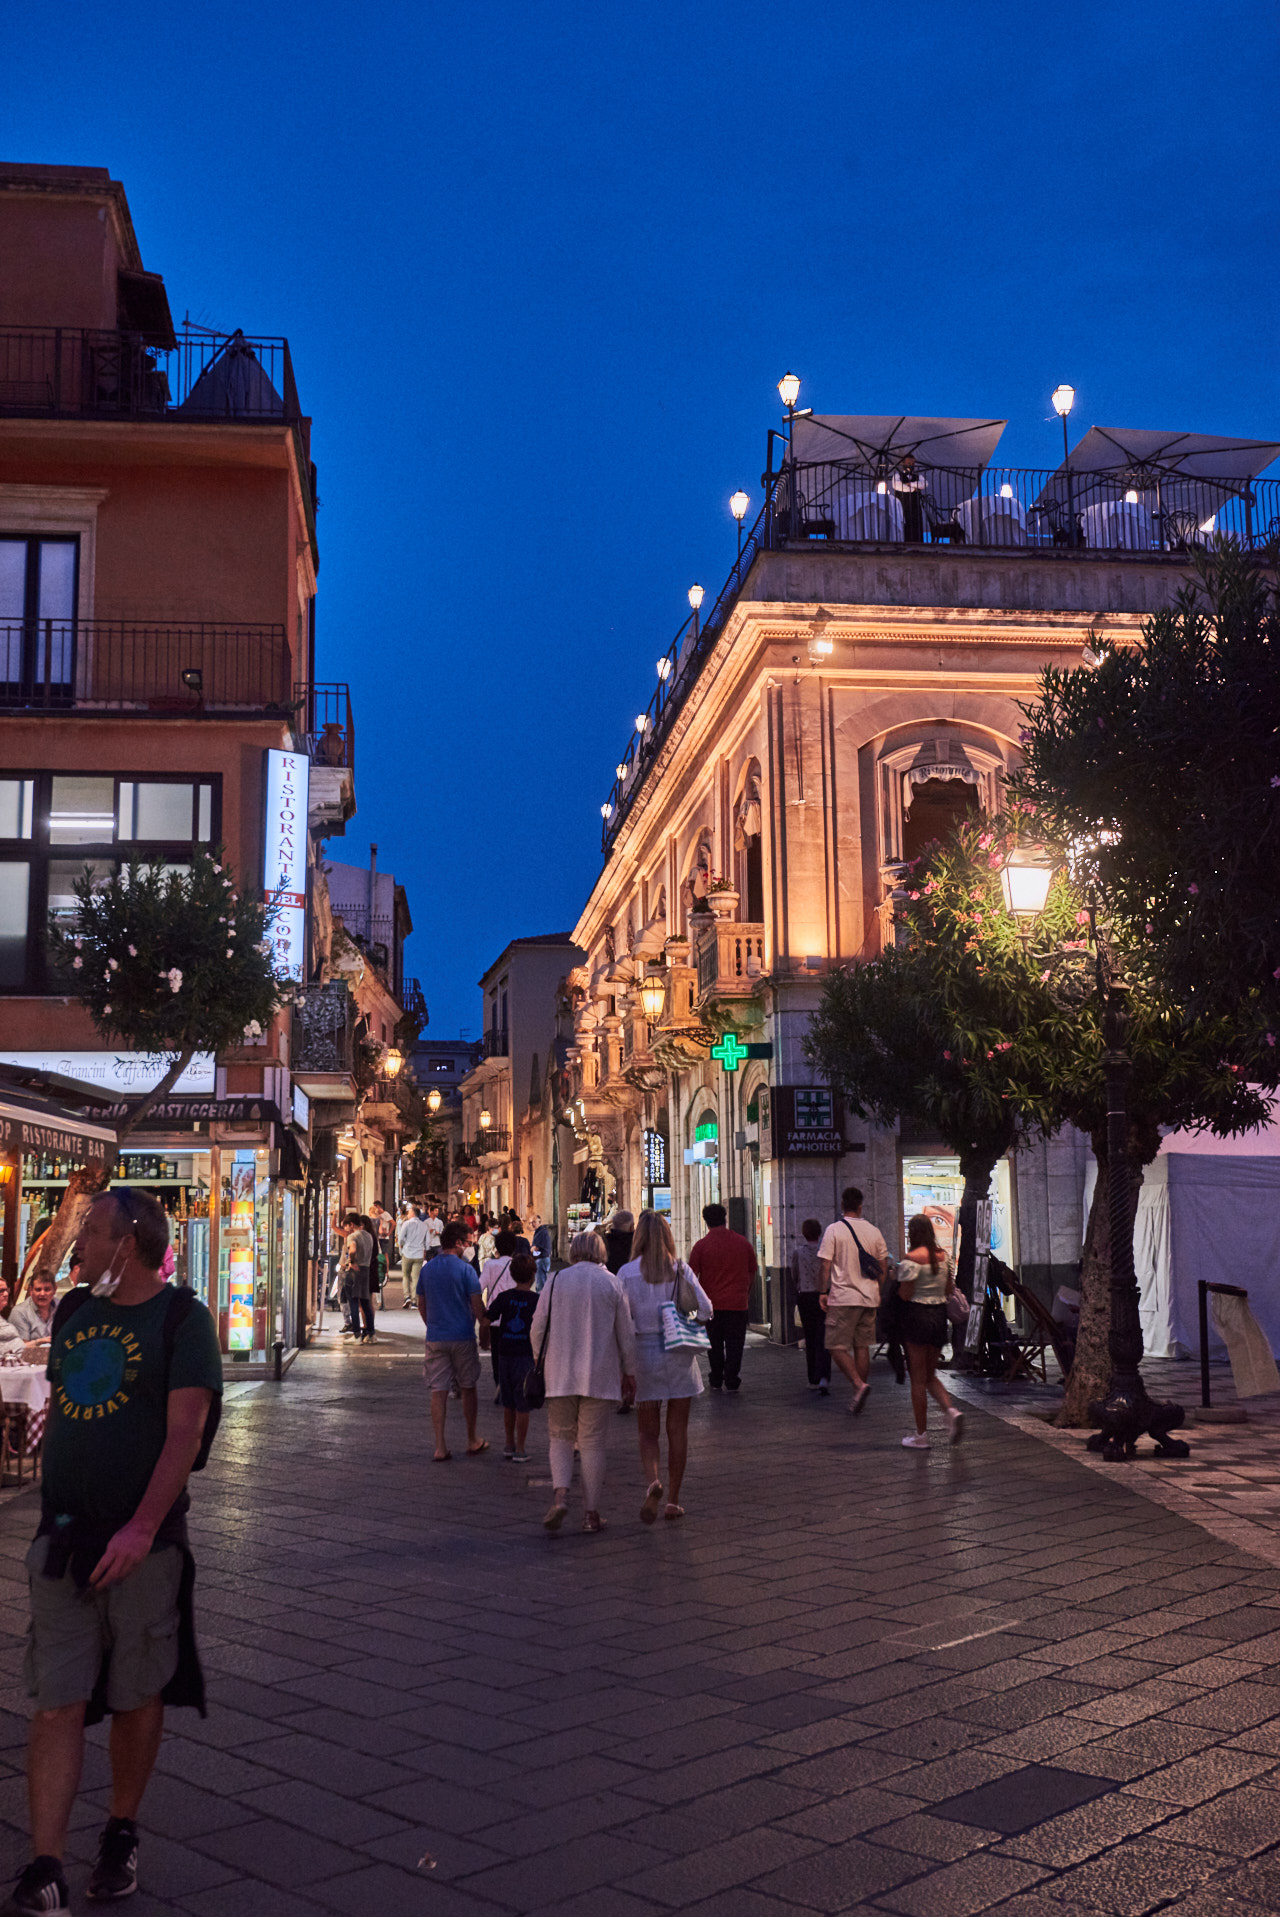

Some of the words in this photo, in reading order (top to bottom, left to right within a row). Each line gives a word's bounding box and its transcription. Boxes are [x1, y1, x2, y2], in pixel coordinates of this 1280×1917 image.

[919, 765, 971, 778] Ristorante
[278, 757, 296, 888] RISTORANT
[268, 892, 301, 907] DEL
[275, 911, 291, 976] CORSO
[22, 1124, 83, 1155] RISTORANTE
[88, 1139, 105, 1158] BAR
[787, 1131, 842, 1141] FARMACIA
[788, 1142, 842, 1152] APHOTEKE
[64, 1324, 123, 1350] EARTH
[121, 1332, 143, 1362] DAY
